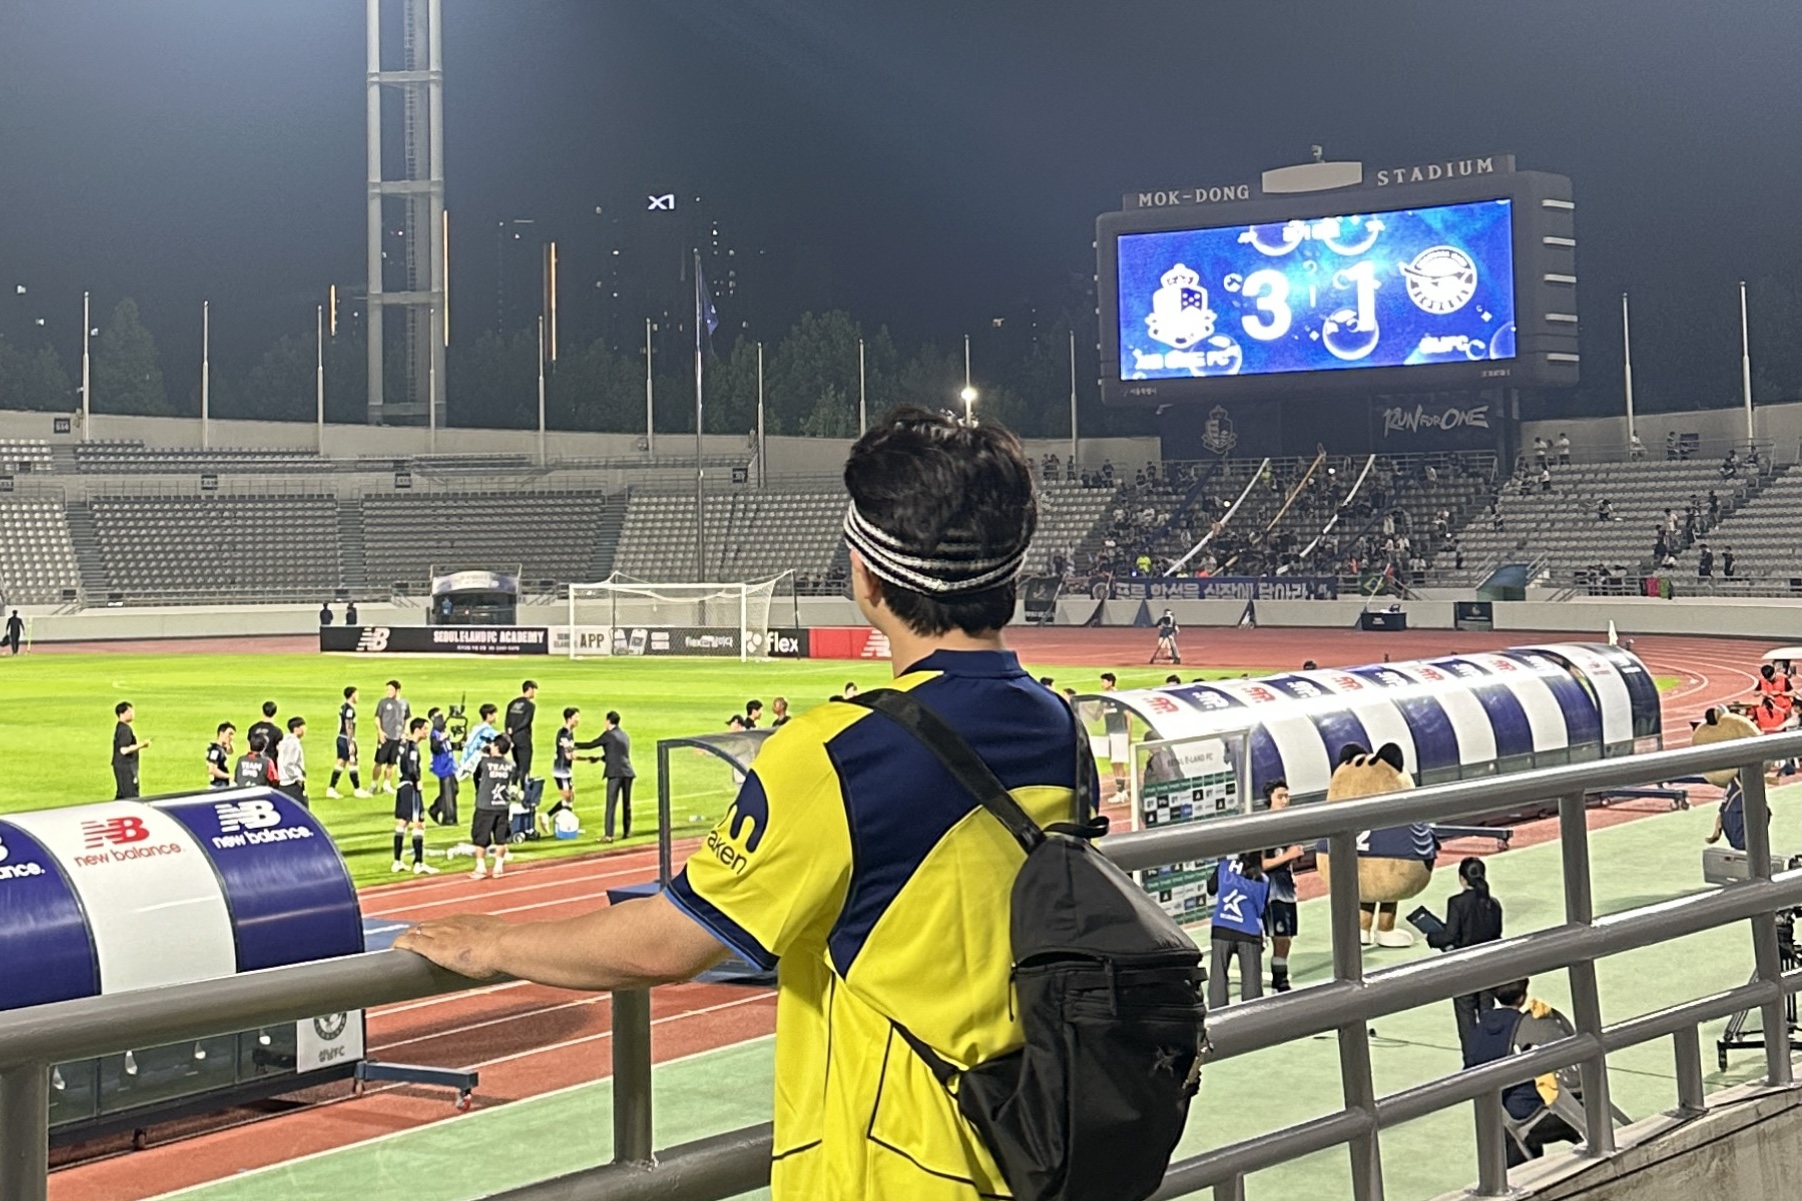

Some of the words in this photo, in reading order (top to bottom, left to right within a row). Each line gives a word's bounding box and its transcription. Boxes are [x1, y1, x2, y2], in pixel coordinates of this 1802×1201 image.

[1138, 185, 1250, 208] MOK-DONG
[1377, 157, 1494, 186] STADIUM
[1241, 268, 1292, 341] 3
[1345, 259, 1375, 332] 1
[1383, 404, 1423, 438] RUN
[1440, 405, 1489, 430] ONE
[499, 631, 545, 644] ACADEMY
[580, 633, 605, 648] APP
[767, 631, 799, 653] flex
[241, 761, 262, 771] TEAM
[487, 763, 513, 772] TEAM
[212, 834, 247, 849] new
[74, 853, 109, 868] new
[706, 829, 748, 876] aken
